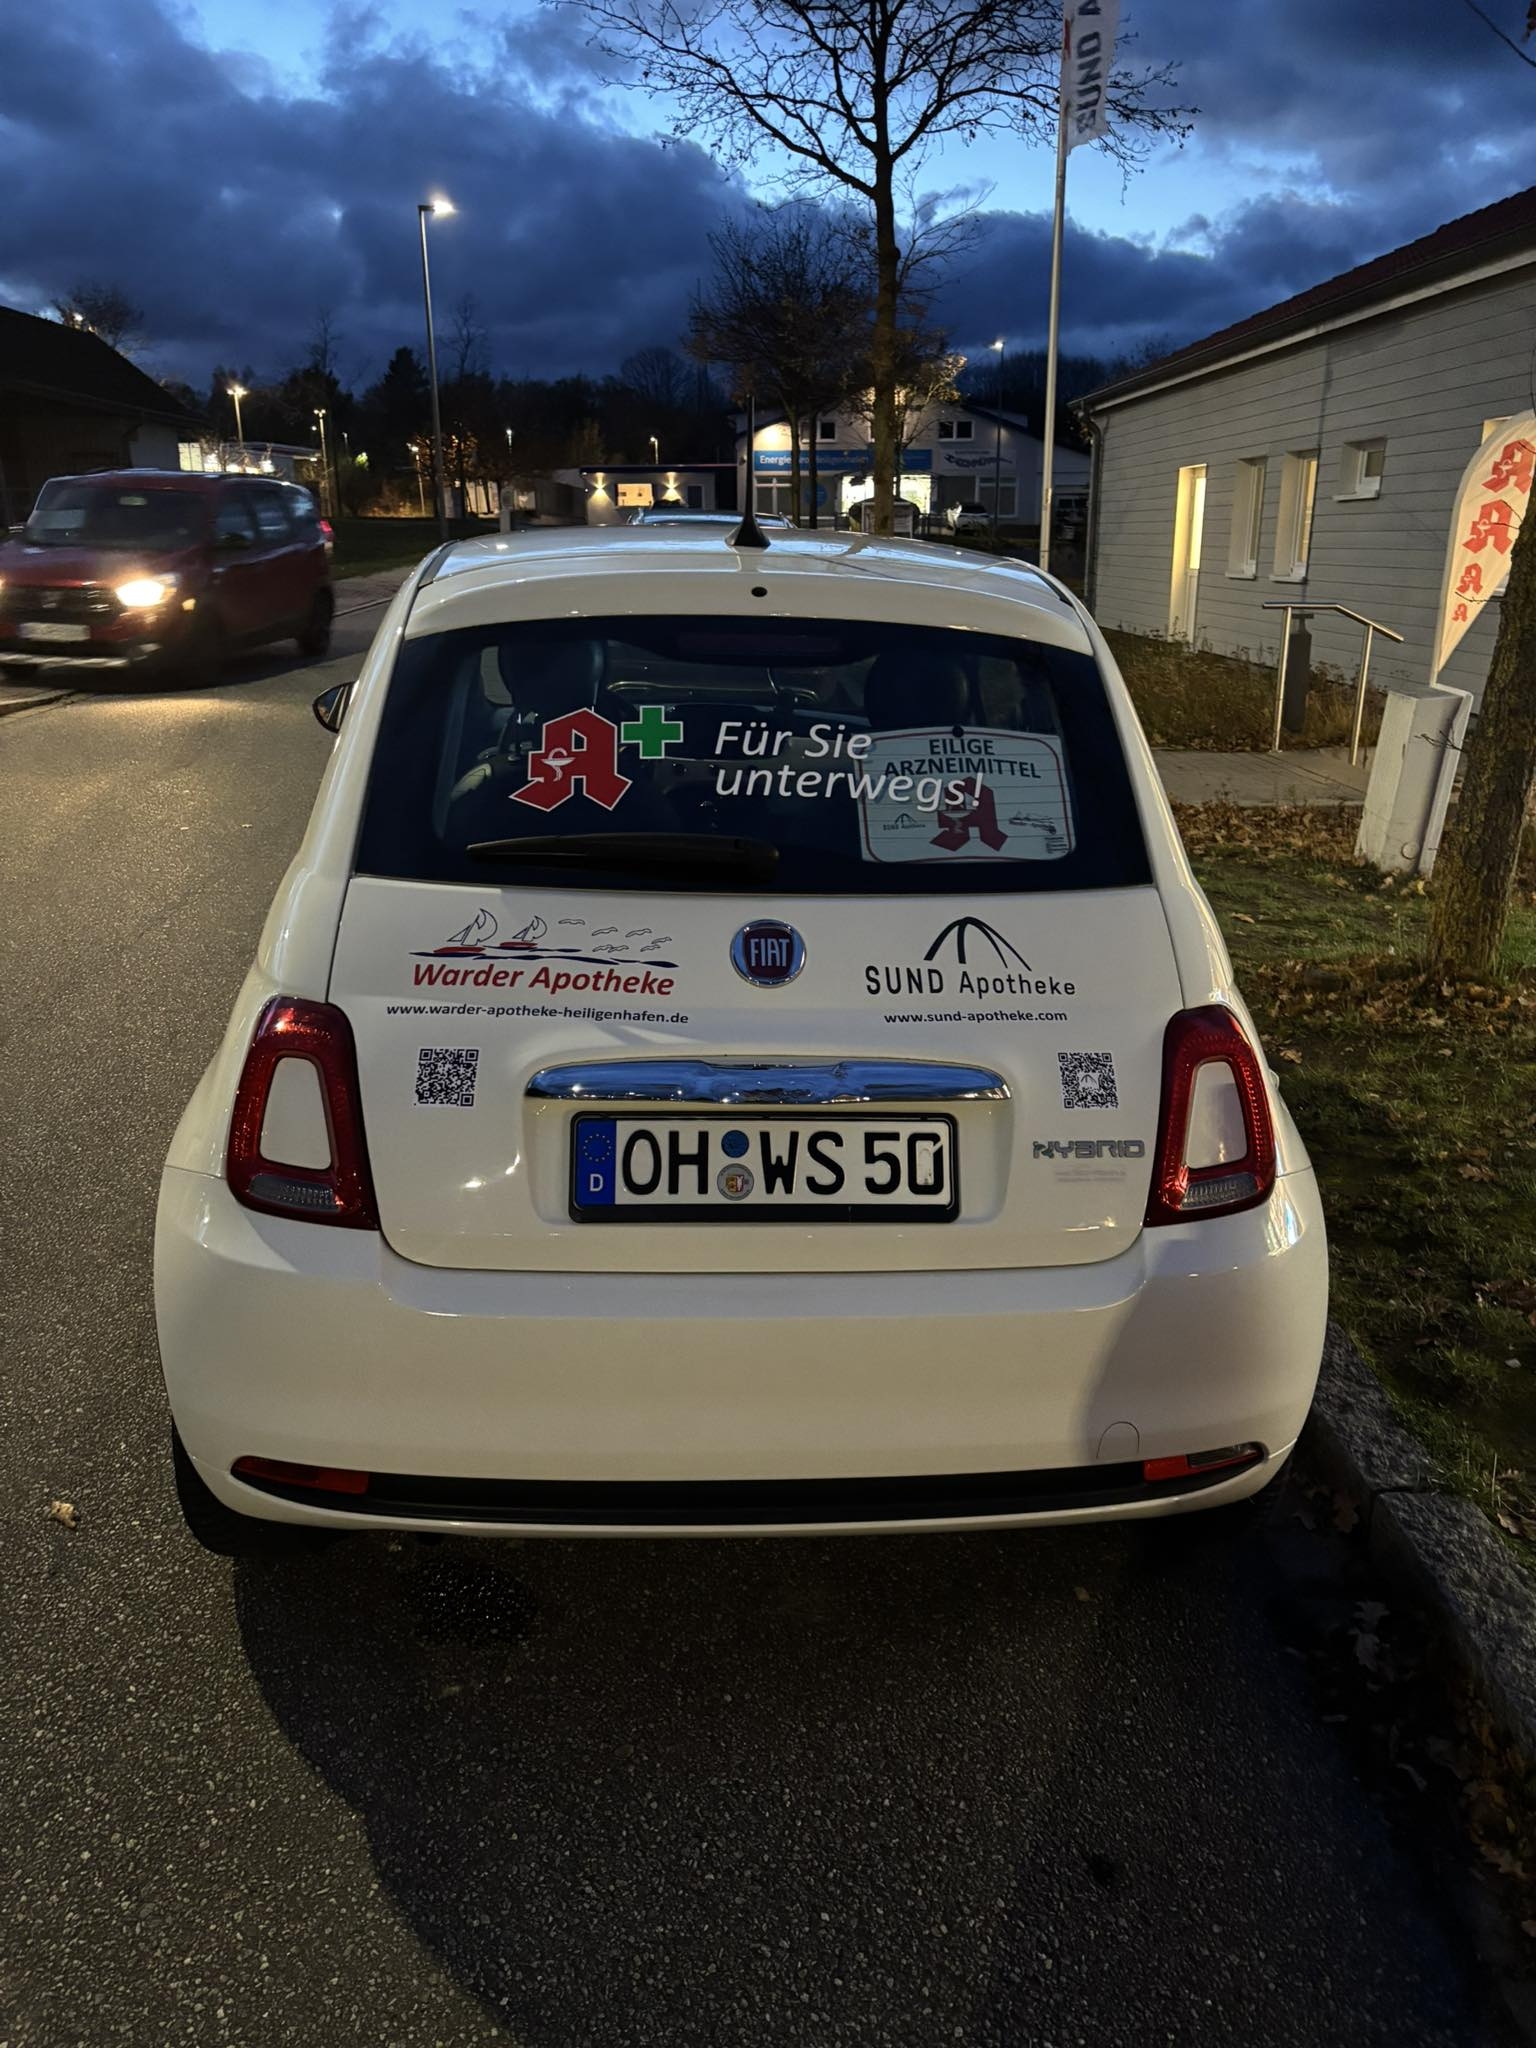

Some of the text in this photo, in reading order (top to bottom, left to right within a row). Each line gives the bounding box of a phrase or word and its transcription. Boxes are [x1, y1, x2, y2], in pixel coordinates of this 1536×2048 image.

[1077, 31, 1102, 134] SUND
[714, 721, 873, 760] Für Sie
[928, 738, 996, 757] EILIGE
[884, 757, 1042, 780] ARZNEIMITTEL
[715, 764, 984, 812] unterwegs!
[750, 937, 790, 968] FIAT
[412, 963, 675, 996] Warder Apotheke
[864, 965, 1077, 1000] SUND Apotheke
[385, 1004, 690, 1025] www.warder-apotheke-heiligenhafen.de
[884, 1009, 1069, 1025] www.sund-apotheke.com
[622, 1130, 709, 1196] OH
[759, 1130, 846, 1196] WS
[864, 1131, 945, 1196] 50
[588, 1173, 605, 1193] D
